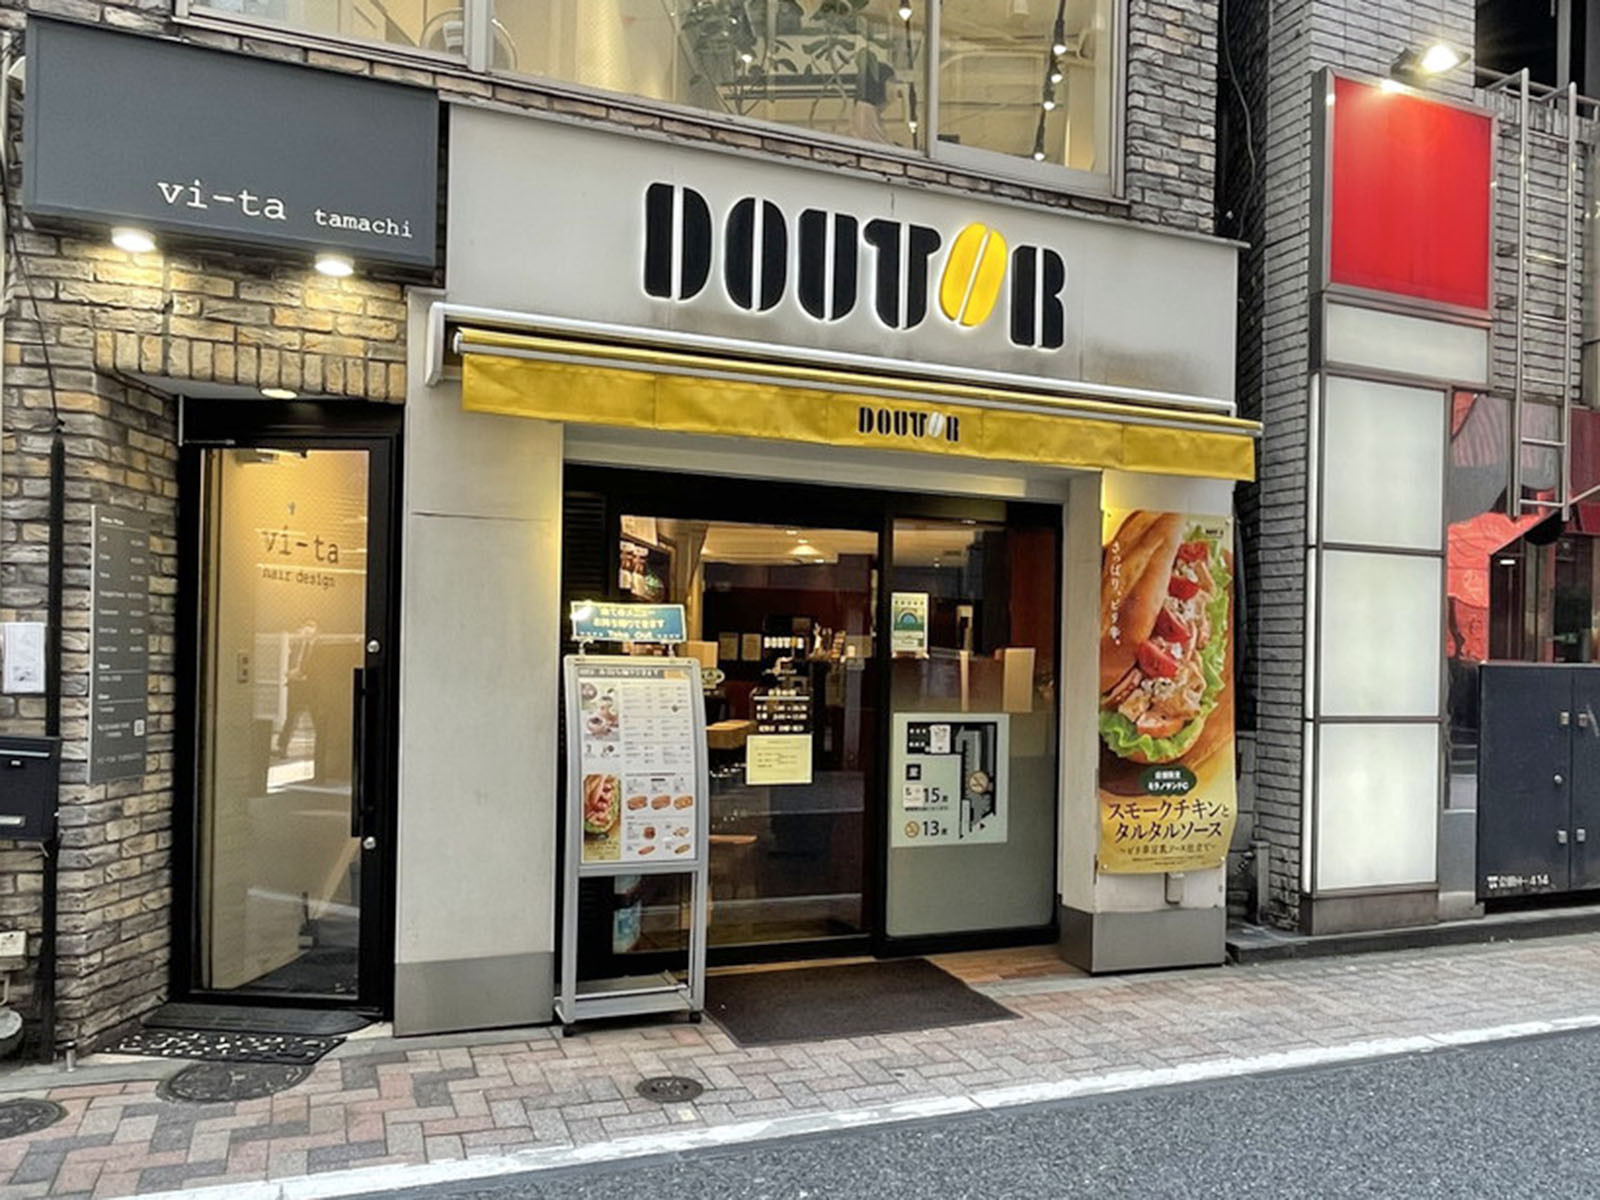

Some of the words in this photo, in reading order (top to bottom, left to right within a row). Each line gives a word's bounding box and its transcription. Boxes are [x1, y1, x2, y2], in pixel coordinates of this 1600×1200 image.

[157, 179, 286, 221] vi-ta
[314, 207, 413, 239] tamachi
[644, 182, 1066, 349] DOUTOR
[858, 406, 960, 443] DOUTOR
[261, 525, 339, 564] vi-ta
[1108, 798, 1230, 820] スモークチキンと
[1115, 821, 1223, 843] タルタルソース
